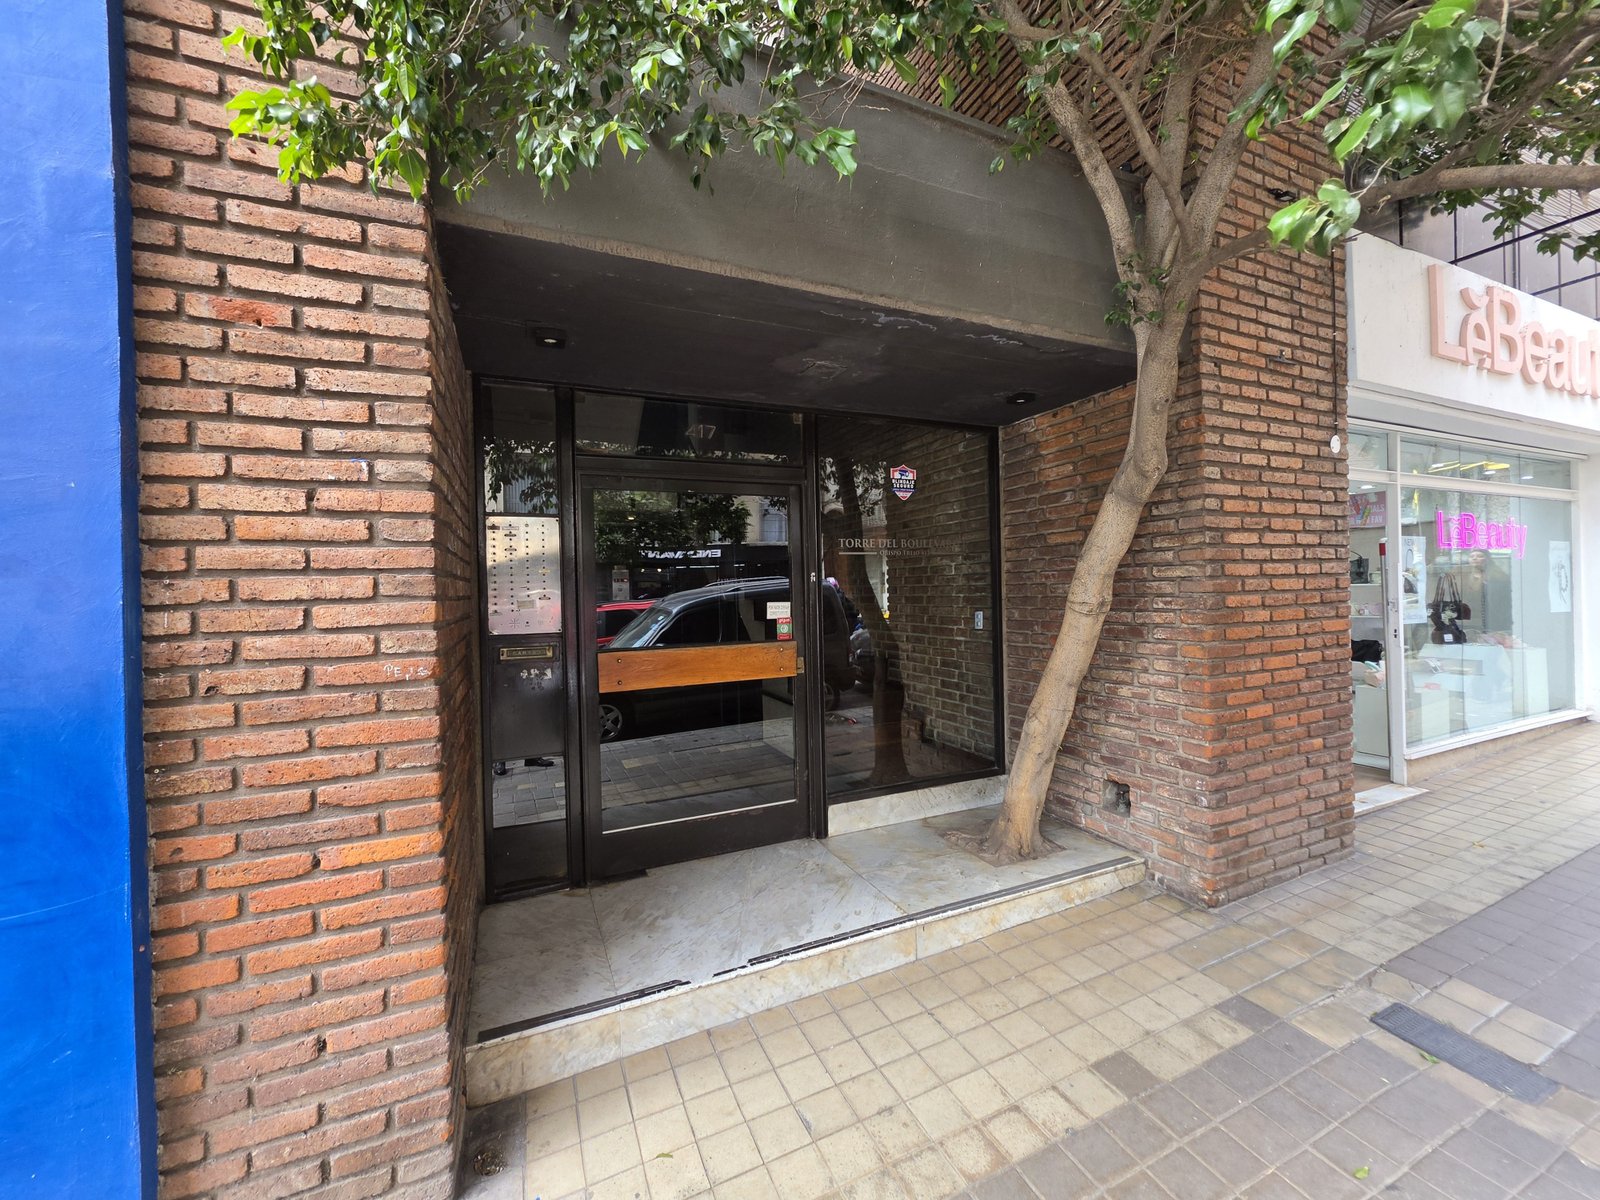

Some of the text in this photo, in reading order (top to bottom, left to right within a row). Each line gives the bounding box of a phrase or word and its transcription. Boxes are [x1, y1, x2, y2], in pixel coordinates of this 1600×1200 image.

[685, 424, 717, 440] 417
[838, 538, 876, 548] TORRE
[878, 538, 898, 548] DEL
